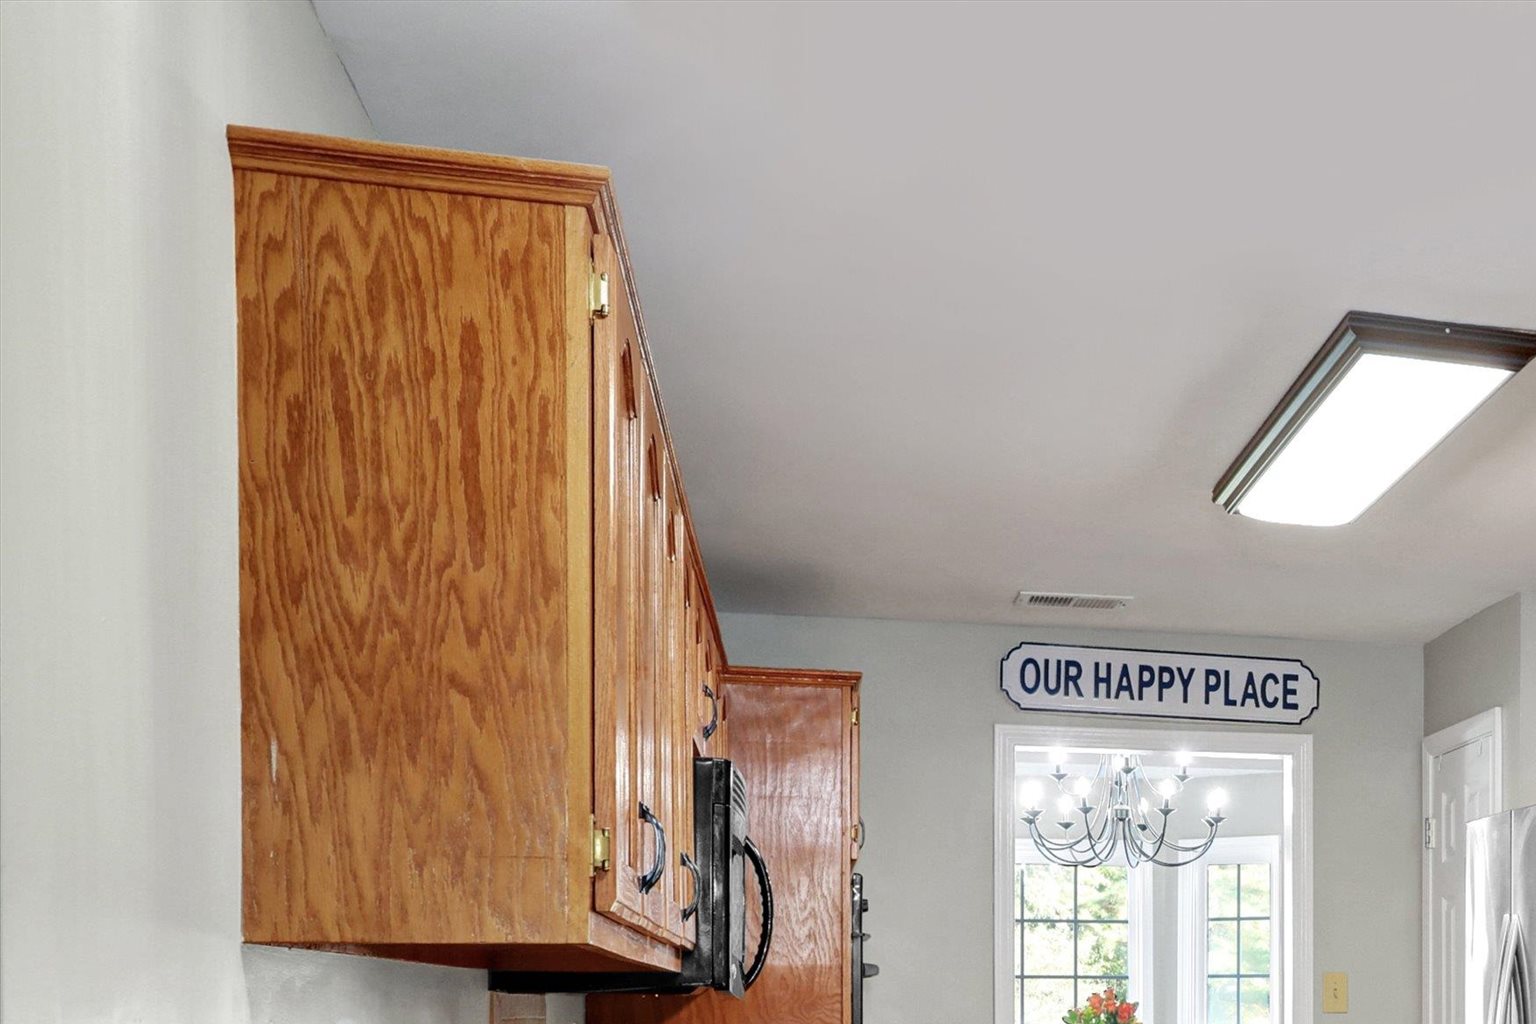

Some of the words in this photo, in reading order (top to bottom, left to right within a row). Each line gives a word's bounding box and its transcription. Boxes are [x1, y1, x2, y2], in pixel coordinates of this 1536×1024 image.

[1019, 657, 1084, 698] OUR
[1093, 661, 1196, 704] HAPPY
[1204, 668, 1299, 711] PLACE
